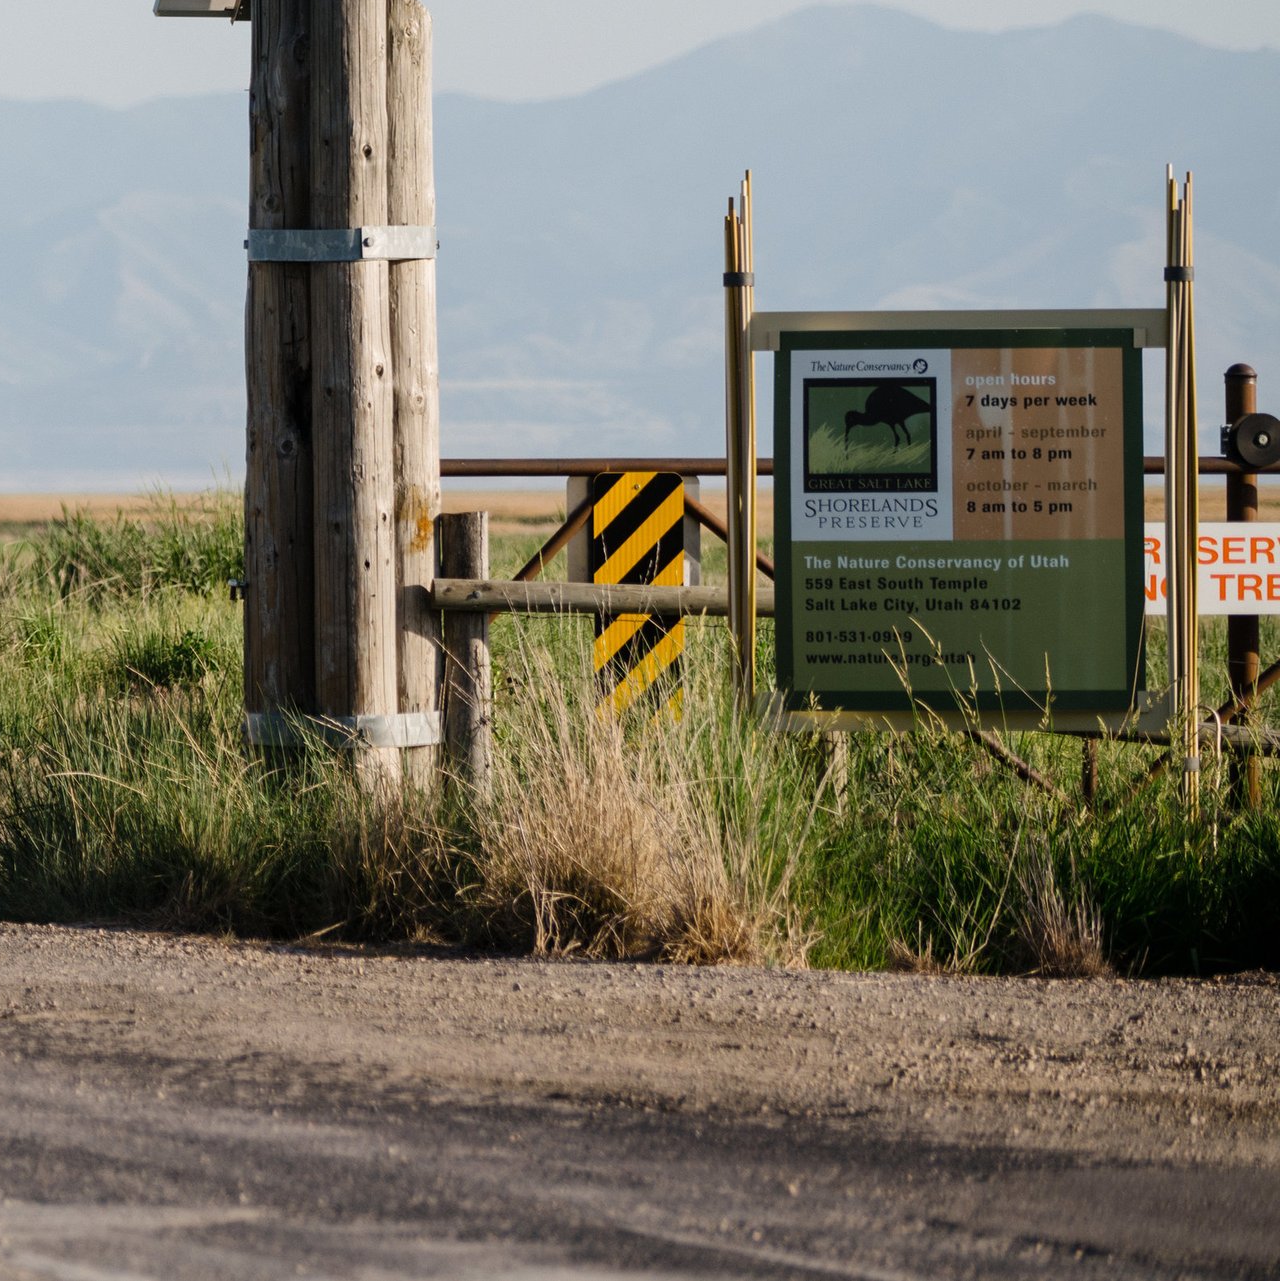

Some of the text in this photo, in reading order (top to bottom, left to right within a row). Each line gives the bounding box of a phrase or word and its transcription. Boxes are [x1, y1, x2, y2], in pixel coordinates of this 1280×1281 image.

[811, 361, 911, 374] The Nature Conservancy
[965, 373, 1056, 389] open hours
[965, 394, 1097, 409] 7 days per week
[966, 426, 1002, 441] april
[1021, 426, 1107, 440] september
[966, 448, 1072, 462] 7 am to 8 pm
[808, 478, 932, 490] GREAT SALT LAKE
[966, 480, 1029, 492] october
[1047, 479, 1098, 492] march
[805, 498, 938, 518] SHORELANDS
[966, 501, 1073, 514] 8 am to 5 pm
[819, 516, 923, 529] PRESERVE
[804, 555, 1070, 571] The Nature Conservancy of Utah
[805, 577, 988, 592] 559 East South Temple
[805, 597, 1022, 613] Salt Lake City, Utah 84102
